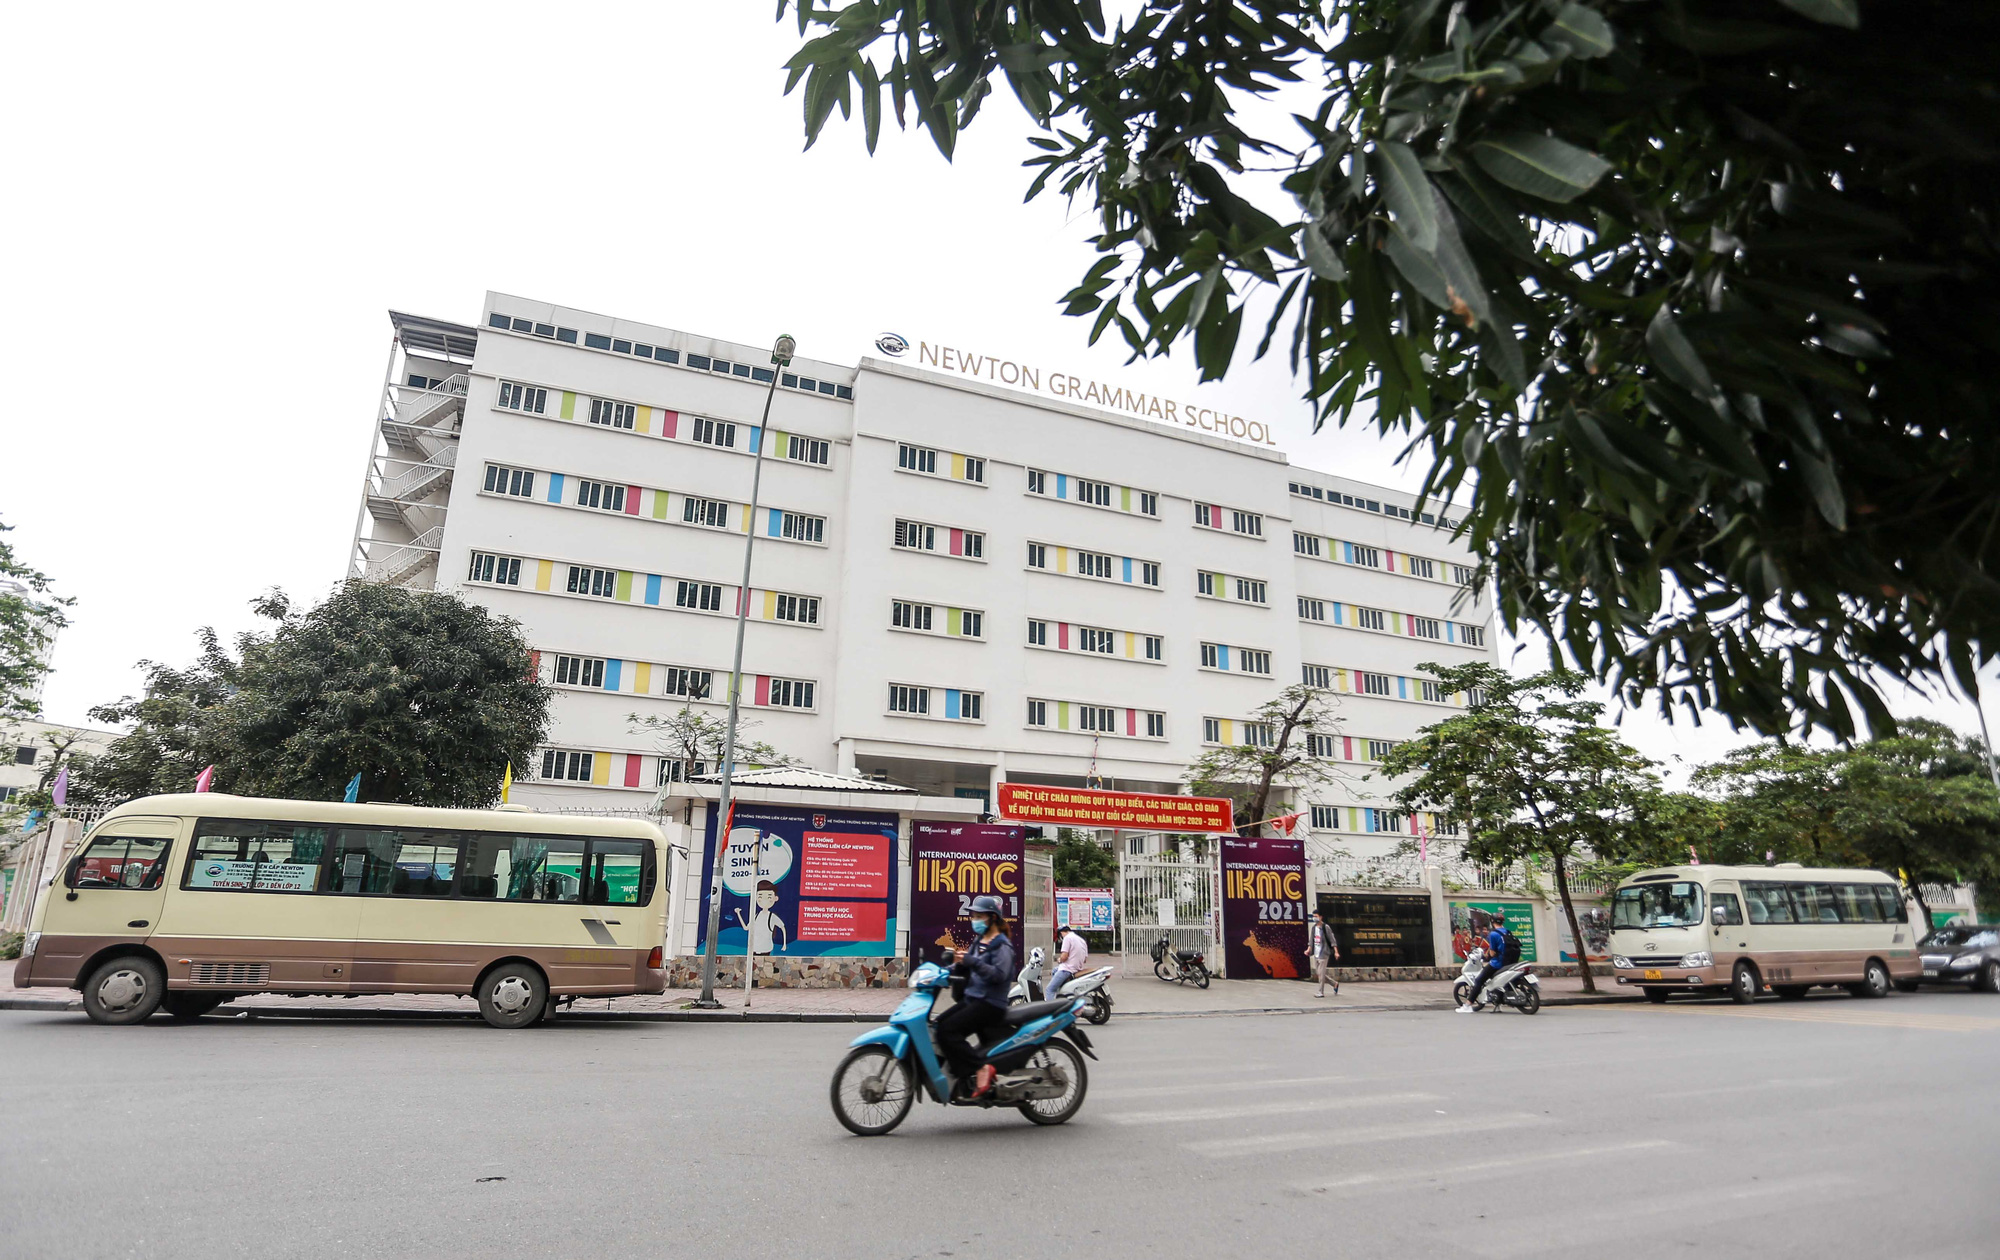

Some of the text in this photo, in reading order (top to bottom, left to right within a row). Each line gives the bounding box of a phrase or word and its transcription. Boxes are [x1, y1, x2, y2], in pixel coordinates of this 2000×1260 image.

[919, 340, 1277, 445] NEWTON GRAMMAR SCHOOL
[1034, 792, 1049, 803] LIỆT
[1050, 793, 1069, 803] CHÀO
[1092, 796, 1106, 806] QUÝ
[1107, 798, 1114, 808] VỊ
[1146, 798, 1159, 809] CÁC
[1204, 802, 1219, 812] GIÁO
[1044, 808, 1055, 816] THI
[1057, 807, 1073, 817] GIÁO
[1187, 817, 1202, 825] 2020
[1208, 818, 1222, 826] 2021
[730, 843, 769, 854] TUYN
[919, 851, 976, 860] INTERNATIONAL
[918, 859, 1018, 894] IKMC
[1226, 870, 1302, 900] IKMC
[1258, 901, 1304, 920] 2021
